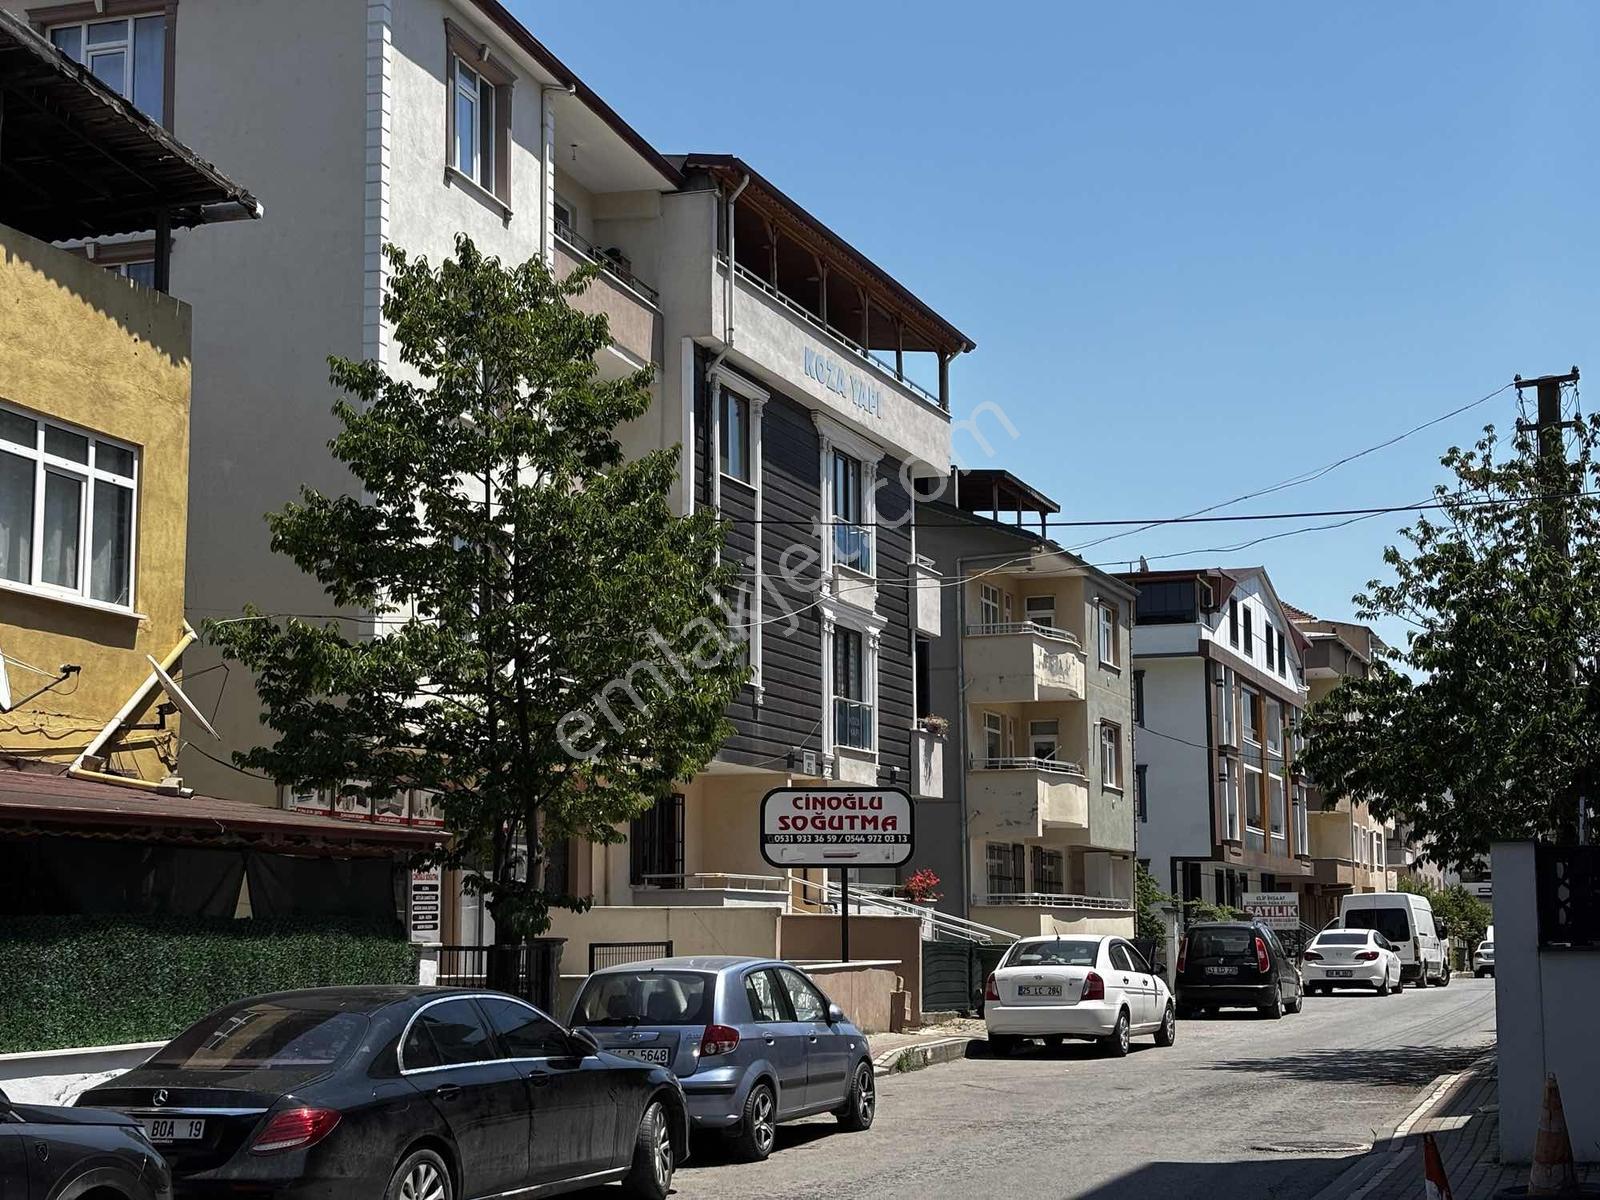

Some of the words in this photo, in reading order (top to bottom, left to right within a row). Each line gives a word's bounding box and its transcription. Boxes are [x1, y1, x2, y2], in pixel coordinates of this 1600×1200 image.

[805, 346, 847, 398] KOZA
[850, 375, 884, 419] YAPI
[792, 793, 883, 811] CİNOĞLU
[778, 811, 897, 832] SOĞUTMA
[774, 834, 793, 843] 0531
[796, 834, 812, 843] 933
[813, 834, 825, 843] 36
[826, 834, 837, 843] 59
[844, 834, 865, 843] 0544
[867, 834, 882, 843] 972
[884, 834, 895, 843] 03
[898, 834, 908, 843] 13
[1245, 906, 1297, 916] SATILIK
[640, 1049, 667, 1062] 5648
[151, 1120, 175, 1137] BOA
[188, 1120, 203, 1138] 19
